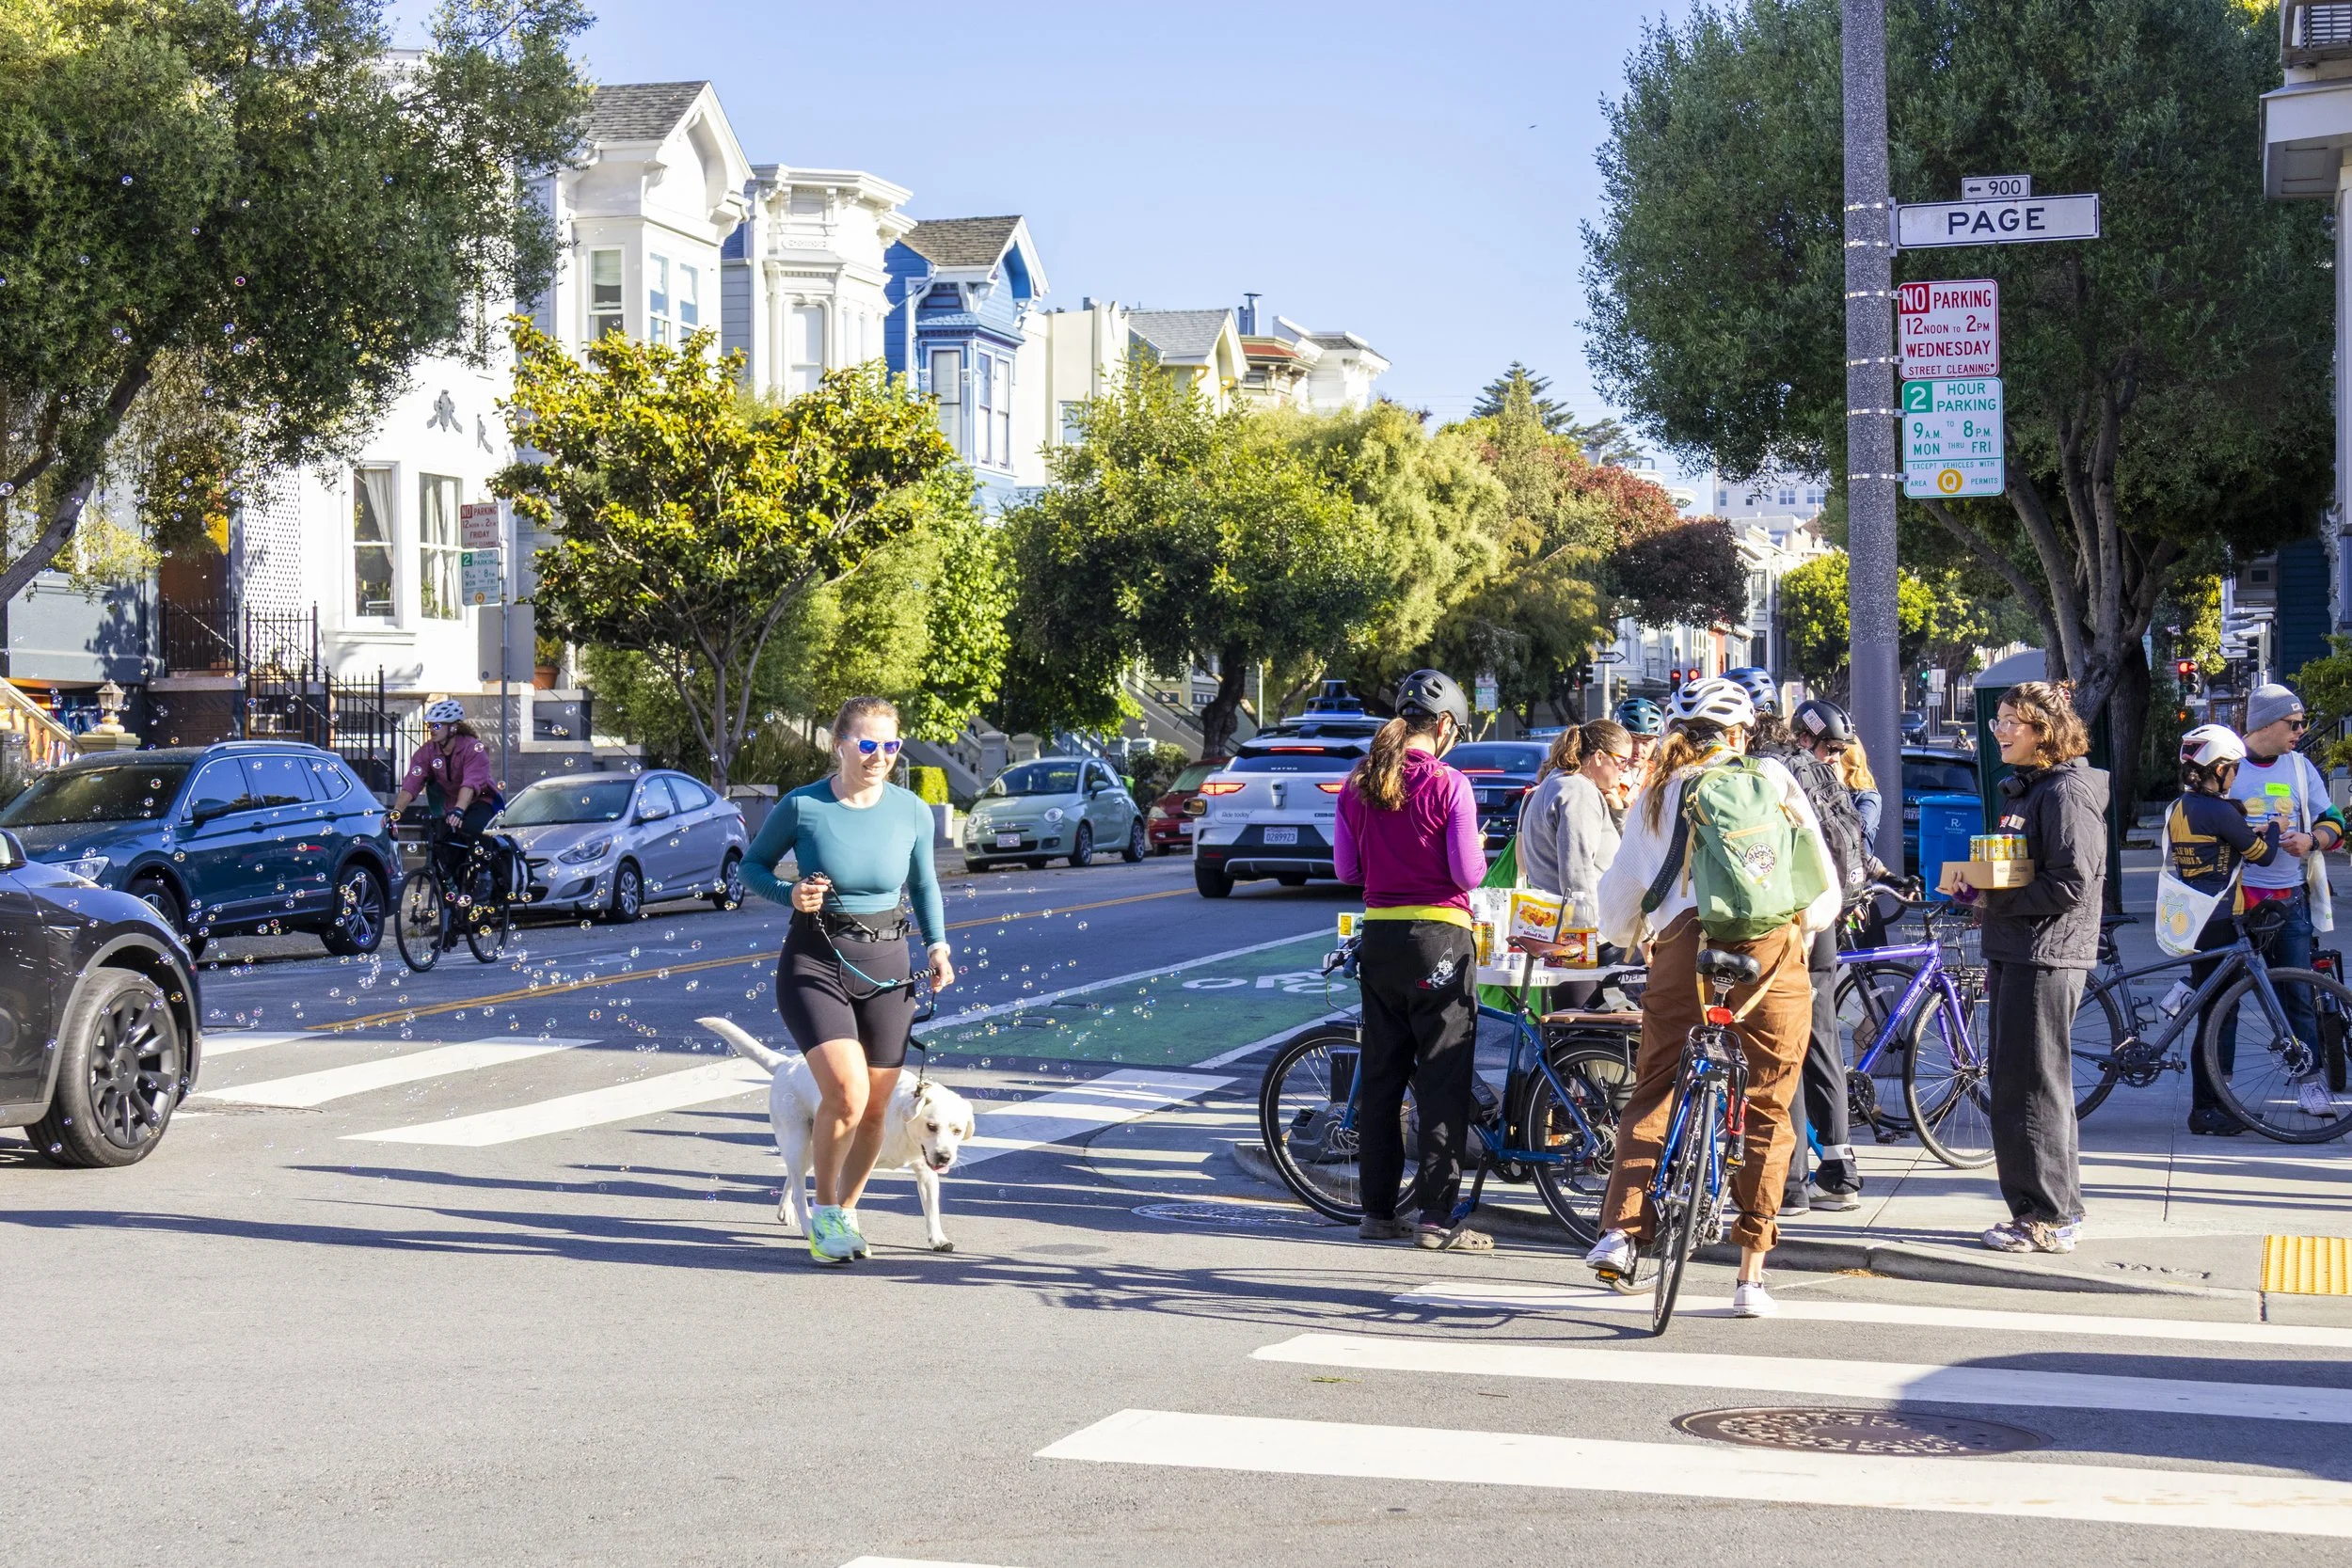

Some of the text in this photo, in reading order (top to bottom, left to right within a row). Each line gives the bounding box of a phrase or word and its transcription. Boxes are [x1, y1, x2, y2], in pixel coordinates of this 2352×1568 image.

[1988, 180, 2021, 196] 900
[1947, 207, 2045, 235] PAGE
[1901, 286, 1992, 311] NO PARKING
[1906, 340, 1991, 358] WEDNESDAY
[1908, 364, 1990, 376] STREET CLEANING
[1910, 383, 1986, 410] 2 HOUR
[1937, 399, 1996, 413] PARKING
[1914, 443, 1941, 455] MON
[1971, 441, 1992, 453] FRI
[1913, 462, 1937, 470] EXCEPT
[1942, 461, 1974, 469] VEHICLES
[1942, 472, 1957, 491] Q
[462, 505, 497, 516] NO PARKING
[470, 531, 489, 539] FRIDAY
[463, 554, 470, 565] 2
